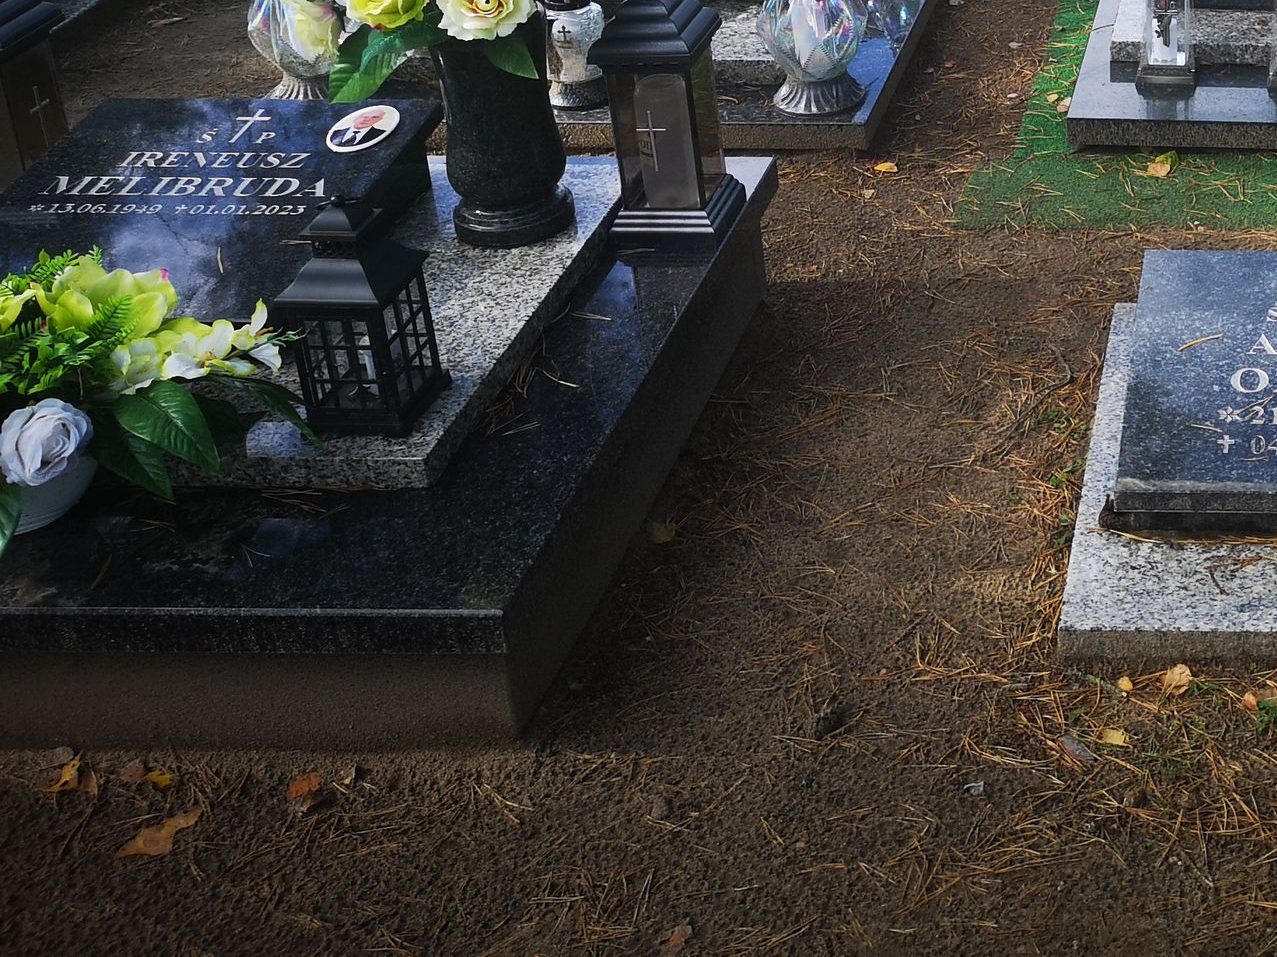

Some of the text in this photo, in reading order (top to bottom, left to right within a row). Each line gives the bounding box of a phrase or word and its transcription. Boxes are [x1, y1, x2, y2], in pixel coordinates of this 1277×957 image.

[256, 132, 276, 144] P
[117, 151, 311, 169] IRENEUSZ
[39, 176, 327, 197] MELIBRUDA
[188, 204, 307, 216] 01.01.2023
